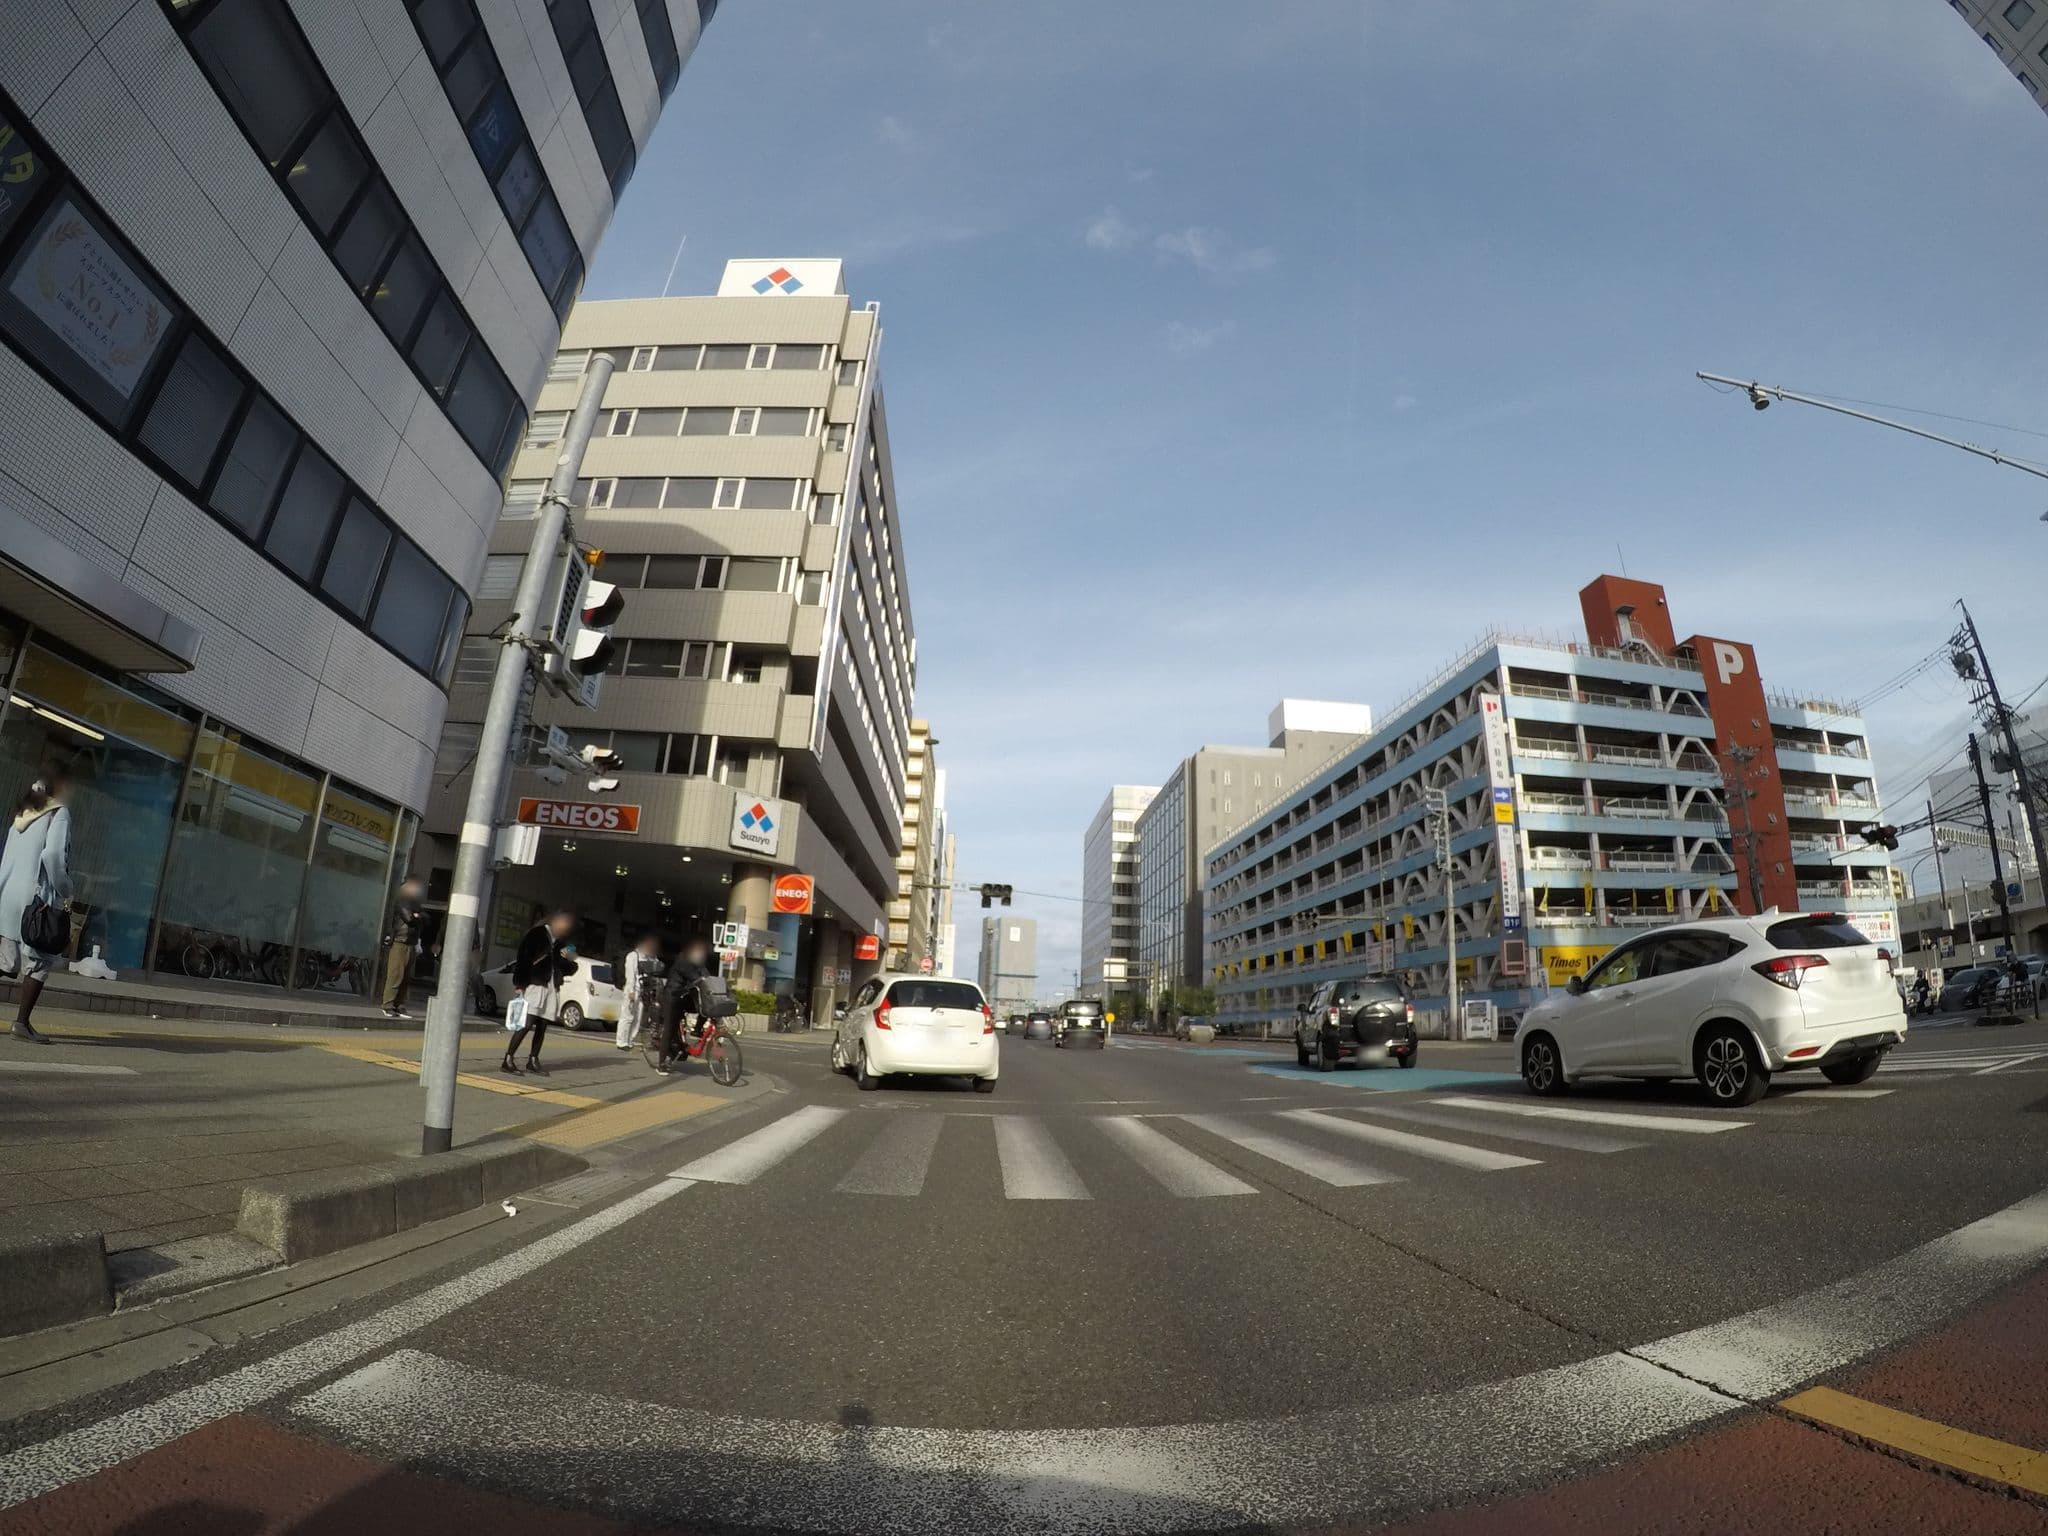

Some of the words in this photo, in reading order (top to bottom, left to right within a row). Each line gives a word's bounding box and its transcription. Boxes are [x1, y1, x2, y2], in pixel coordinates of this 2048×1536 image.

[67, 272, 119, 330] No.1
[1713, 642, 1744, 685] P
[535, 802, 620, 829] ENEOS
[740, 831, 770, 846] Suzuyo
[775, 889, 809, 899] ENEOS
[1549, 955, 1582, 968] Times
